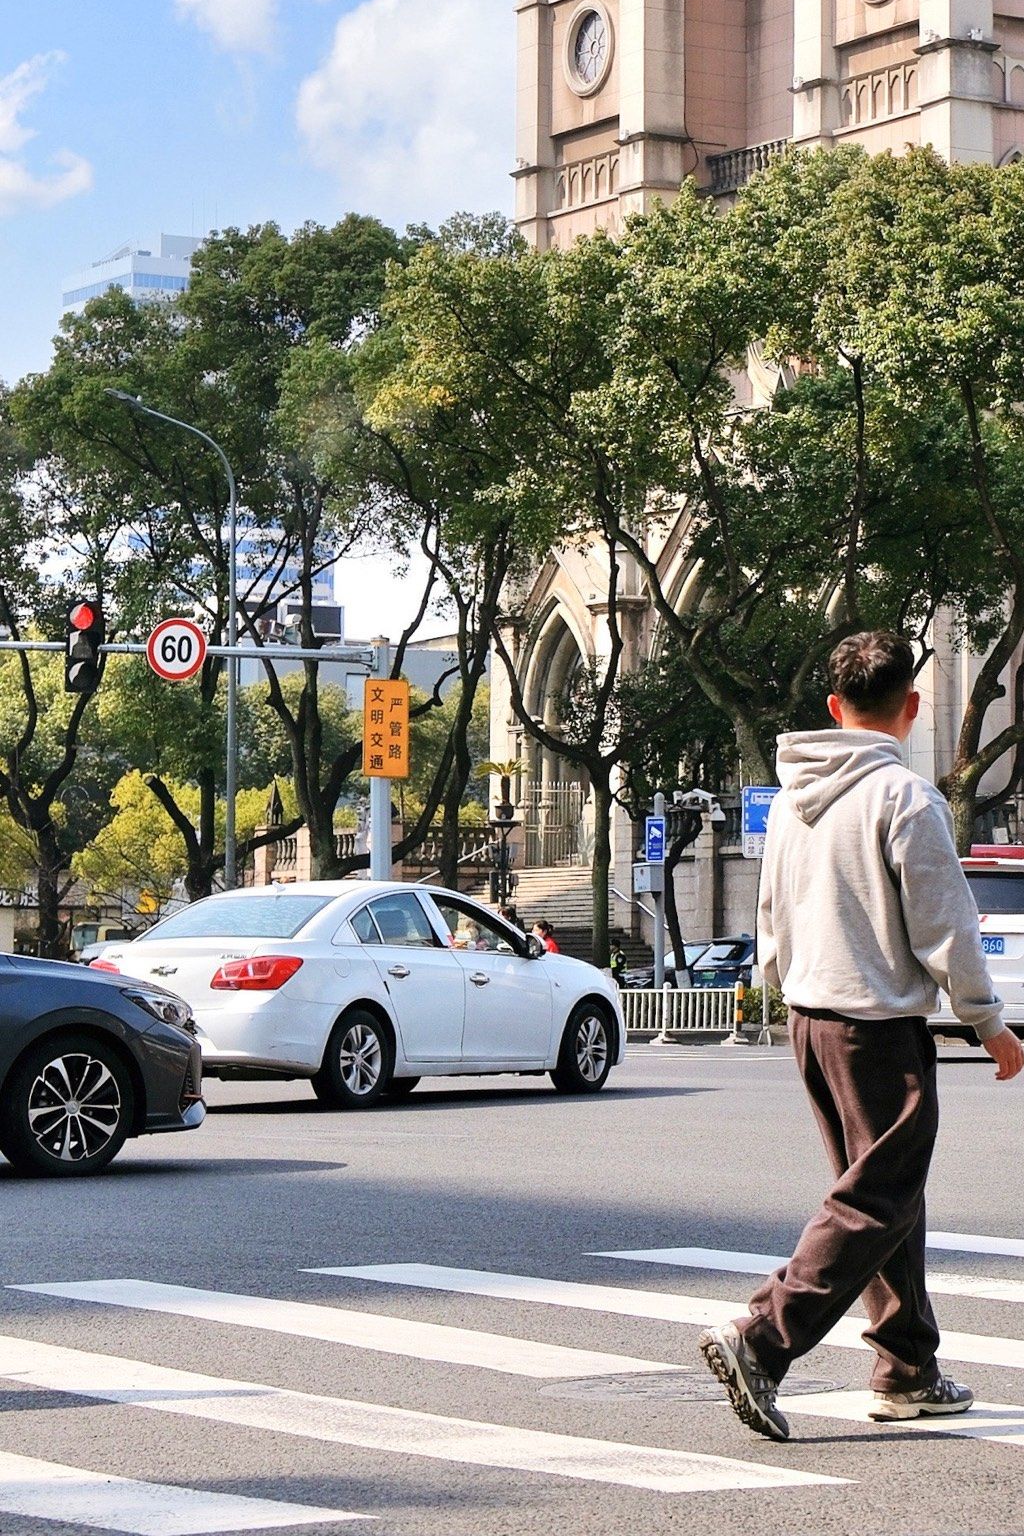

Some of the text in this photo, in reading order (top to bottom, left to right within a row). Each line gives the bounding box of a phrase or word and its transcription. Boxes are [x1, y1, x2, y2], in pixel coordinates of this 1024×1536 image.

[161, 635, 192, 663] 60
[370, 687, 384, 770] 文明交通
[389, 698, 402, 759] 严管路
